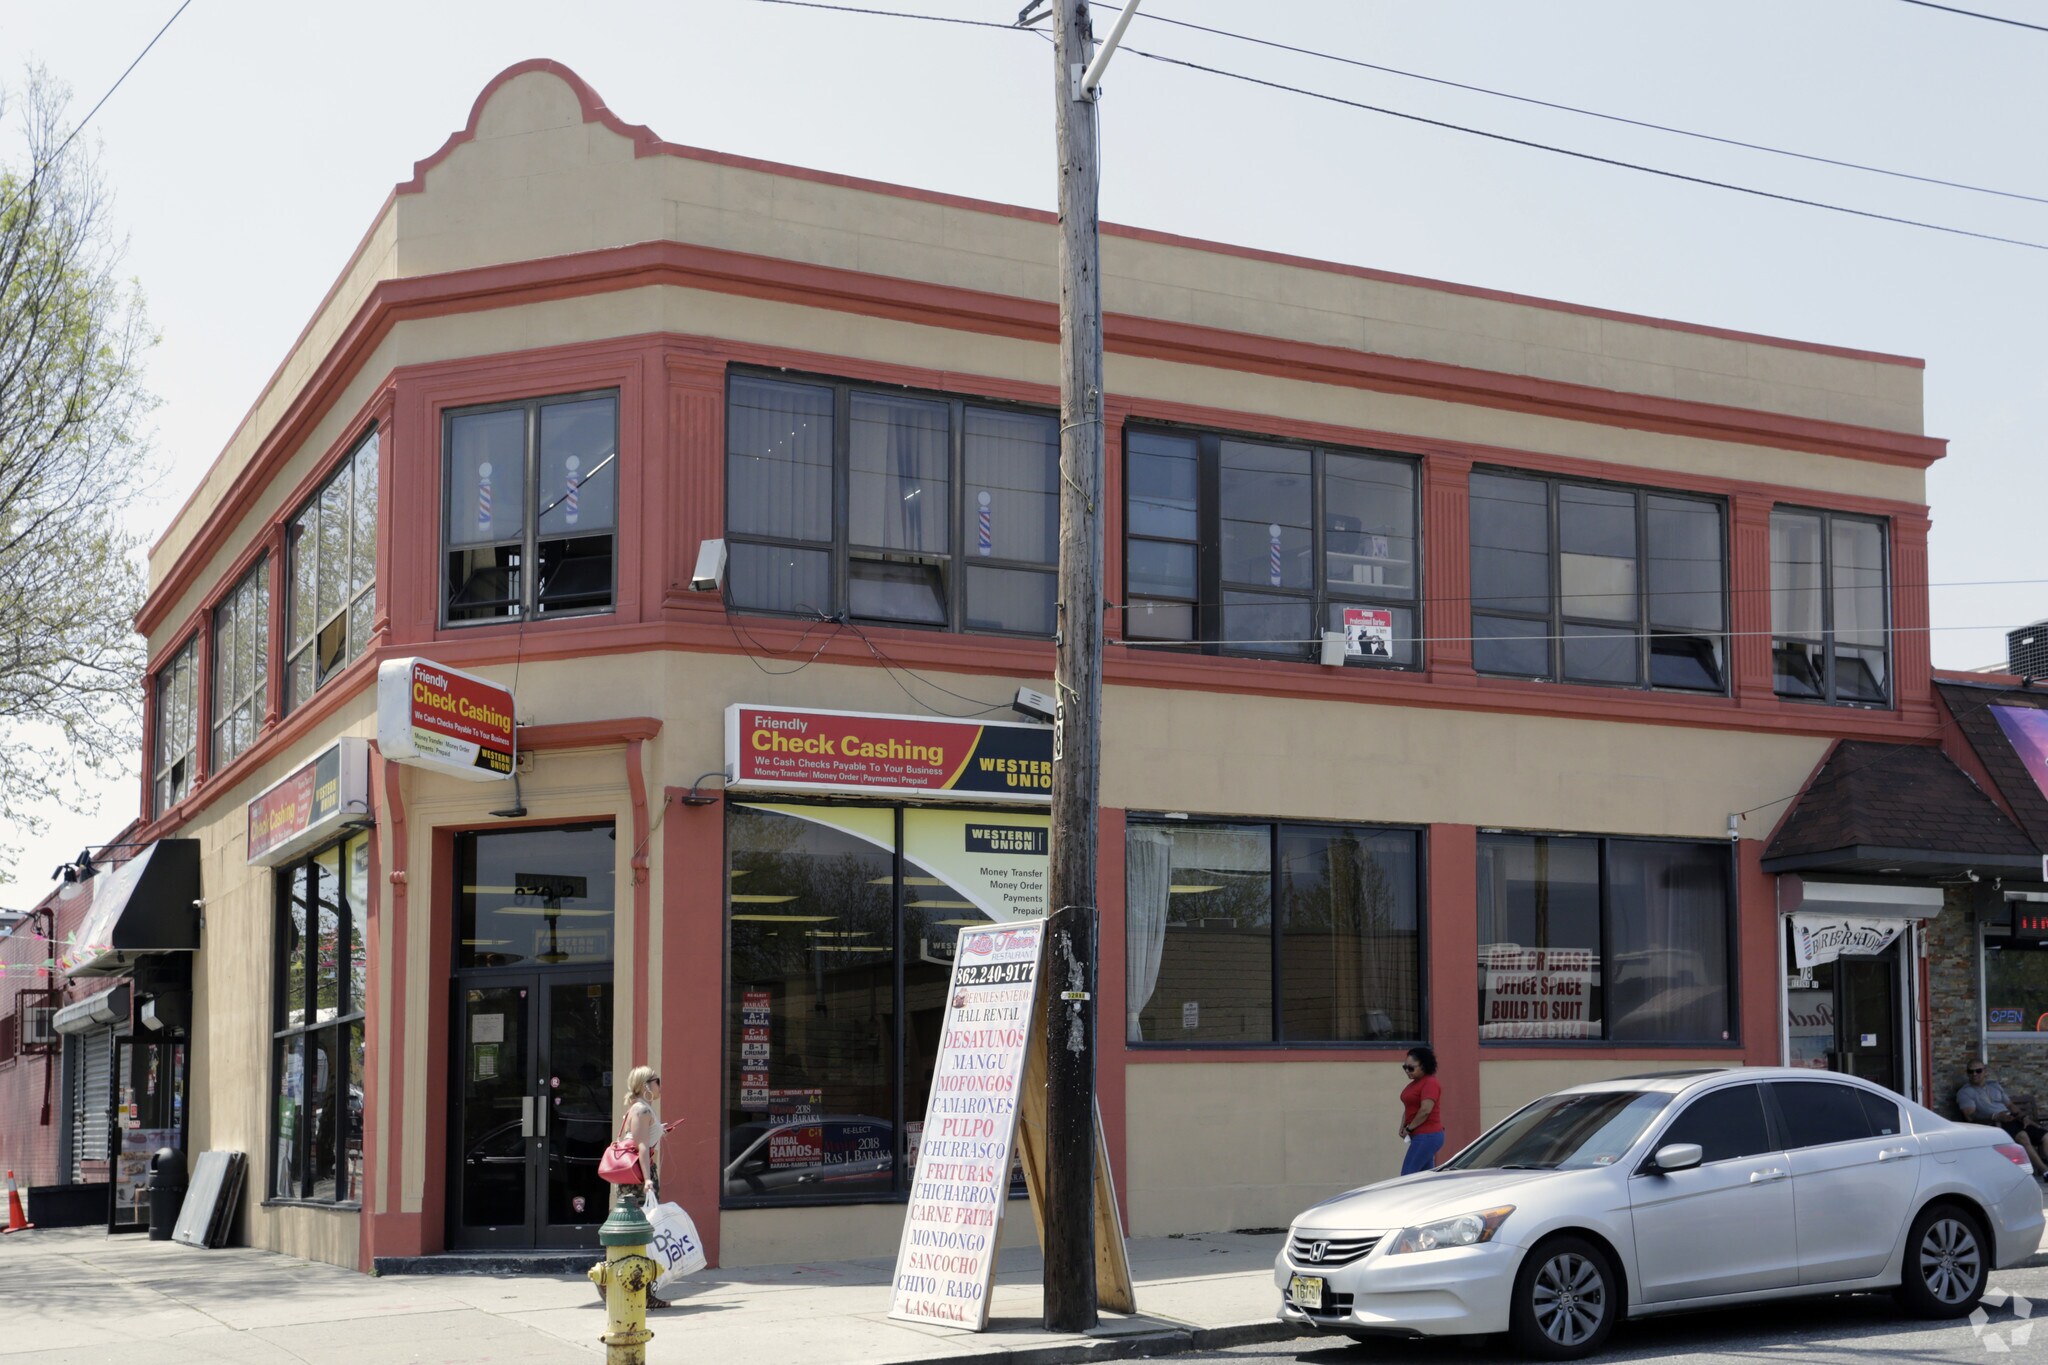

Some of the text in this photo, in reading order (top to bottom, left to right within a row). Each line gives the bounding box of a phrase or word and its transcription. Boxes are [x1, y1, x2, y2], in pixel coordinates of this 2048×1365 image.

[415, 667, 448, 691] Friendly
[413, 682, 511, 733] Check Cashing
[415, 711, 509, 746] We Cash Checks Payable To Your Business
[755, 716, 808, 733] Friendly
[415, 732, 470, 753] Money Transfer Money Order
[415, 742, 450, 757] Payments Prepaid
[752, 729, 944, 766] Check Cashing
[481, 749, 510, 763] WESTERN
[490, 760, 510, 771] UNION
[755, 756, 943, 775] We Cash Checks Payable To Your Business
[979, 758, 1052, 774] WESTER
[755, 768, 928, 785] Money Transfer Money Order Payments Prepaid
[1007, 774, 1052, 789] UNIO
[270, 802, 295, 831] Cashing
[972, 829, 1032, 840] WESTERN
[991, 840, 1032, 850] UNION
[980, 867, 1043, 878] Money Transfer
[990, 880, 1043, 890] Money Order
[1003, 894, 1043, 903] Payments
[1013, 907, 1043, 916] Prepaid
[992, 951, 1033, 961] RESTAURANT
[1527, 951, 1545, 971] OR
[1549, 951, 1589, 972] LEASE
[956, 963, 1035, 985] 862.240-9177
[1496, 976, 1582, 996] OFFICE SPACE
[957, 1007, 1020, 1022] HALL RENTAL
[1491, 1001, 1583, 1020] BUILD TO SUIT
[1990, 1009, 2023, 1023] OPEN
[943, 1028, 1025, 1049] DESAYUNOS
[952, 1053, 1008, 1070] MANGU
[938, 1075, 1013, 1092] MOFONGOS
[795, 1104, 811, 1114] 2018
[932, 1097, 1014, 1114] CAMARONES
[792, 1113, 820, 1123] BARAKA
[843, 1126, 871, 1135] RE-ELECT
[941, 1118, 994, 1137] PULPO
[770, 1136, 799, 1145] ANIBAL
[858, 1138, 879, 1150] 2018
[770, 1144, 812, 1158] RAMOS
[824, 1149, 892, 1166] RAS J. BARAKA
[923, 1140, 1006, 1160] CHURRASCO
[926, 1163, 993, 1183] FRITURAS
[911, 1204, 994, 1227] CARNE FRITA
[910, 1229, 985, 1252] MONDONGO
[909, 1252, 978, 1276] SANCOCHO
[898, 1274, 936, 1295] CHIVO
[946, 1280, 983, 1300] RABO
[905, 1298, 964, 1321] LASAGNA
